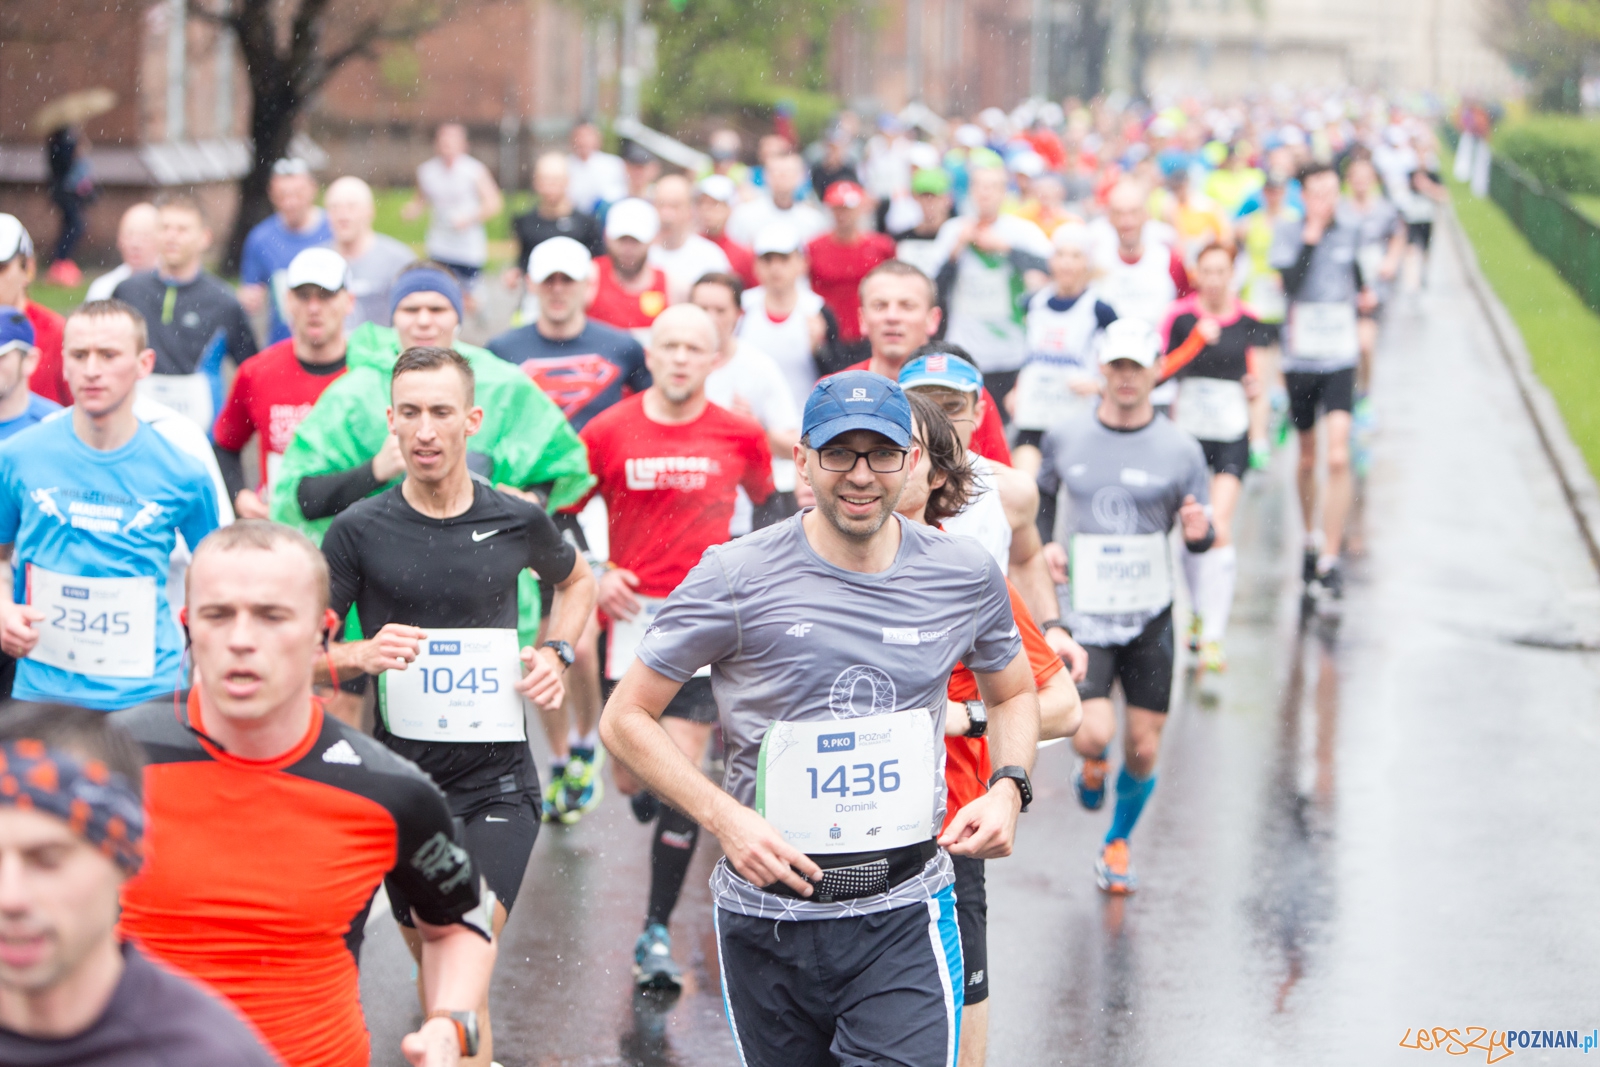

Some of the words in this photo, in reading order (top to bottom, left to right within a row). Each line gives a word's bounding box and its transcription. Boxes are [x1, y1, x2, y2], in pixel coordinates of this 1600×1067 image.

[51, 605, 130, 635] 2345
[785, 623, 814, 637] 4F
[419, 668, 499, 694] 1045
[447, 699, 476, 708] Jakub
[822, 737, 851, 749] 9.PKO
[806, 759, 901, 799] 1436
[835, 801, 878, 813] Dominik
[866, 827, 882, 836] 4F
